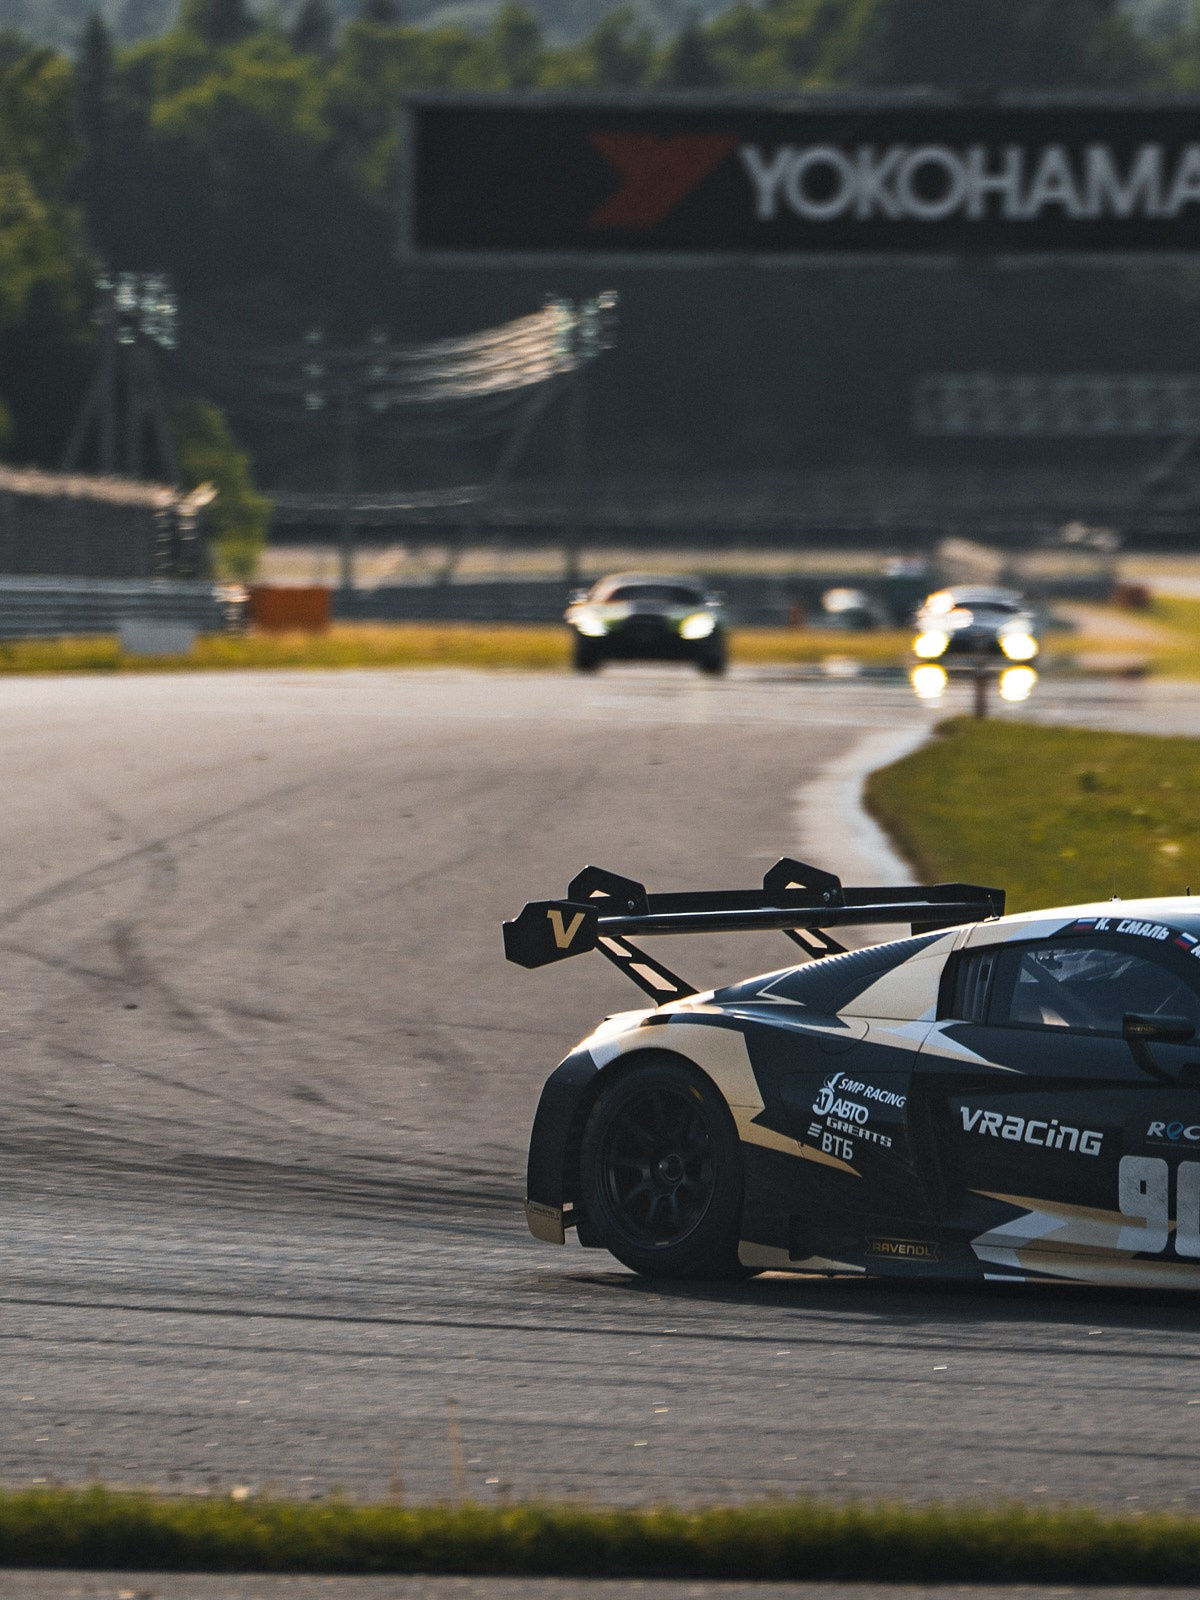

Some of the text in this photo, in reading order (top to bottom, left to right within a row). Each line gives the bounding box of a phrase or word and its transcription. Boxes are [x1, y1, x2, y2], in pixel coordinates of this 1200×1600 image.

[546, 909, 586, 949] V
[1094, 918, 1170, 941] К. СМАЛЬ
[838, 1078, 907, 1108] SMP RACING
[829, 1097, 869, 1125] АВТО
[821, 1131, 854, 1161] ВТБ
[826, 1116, 892, 1148] GREATS
[872, 1241, 932, 1256] RAVENOL
